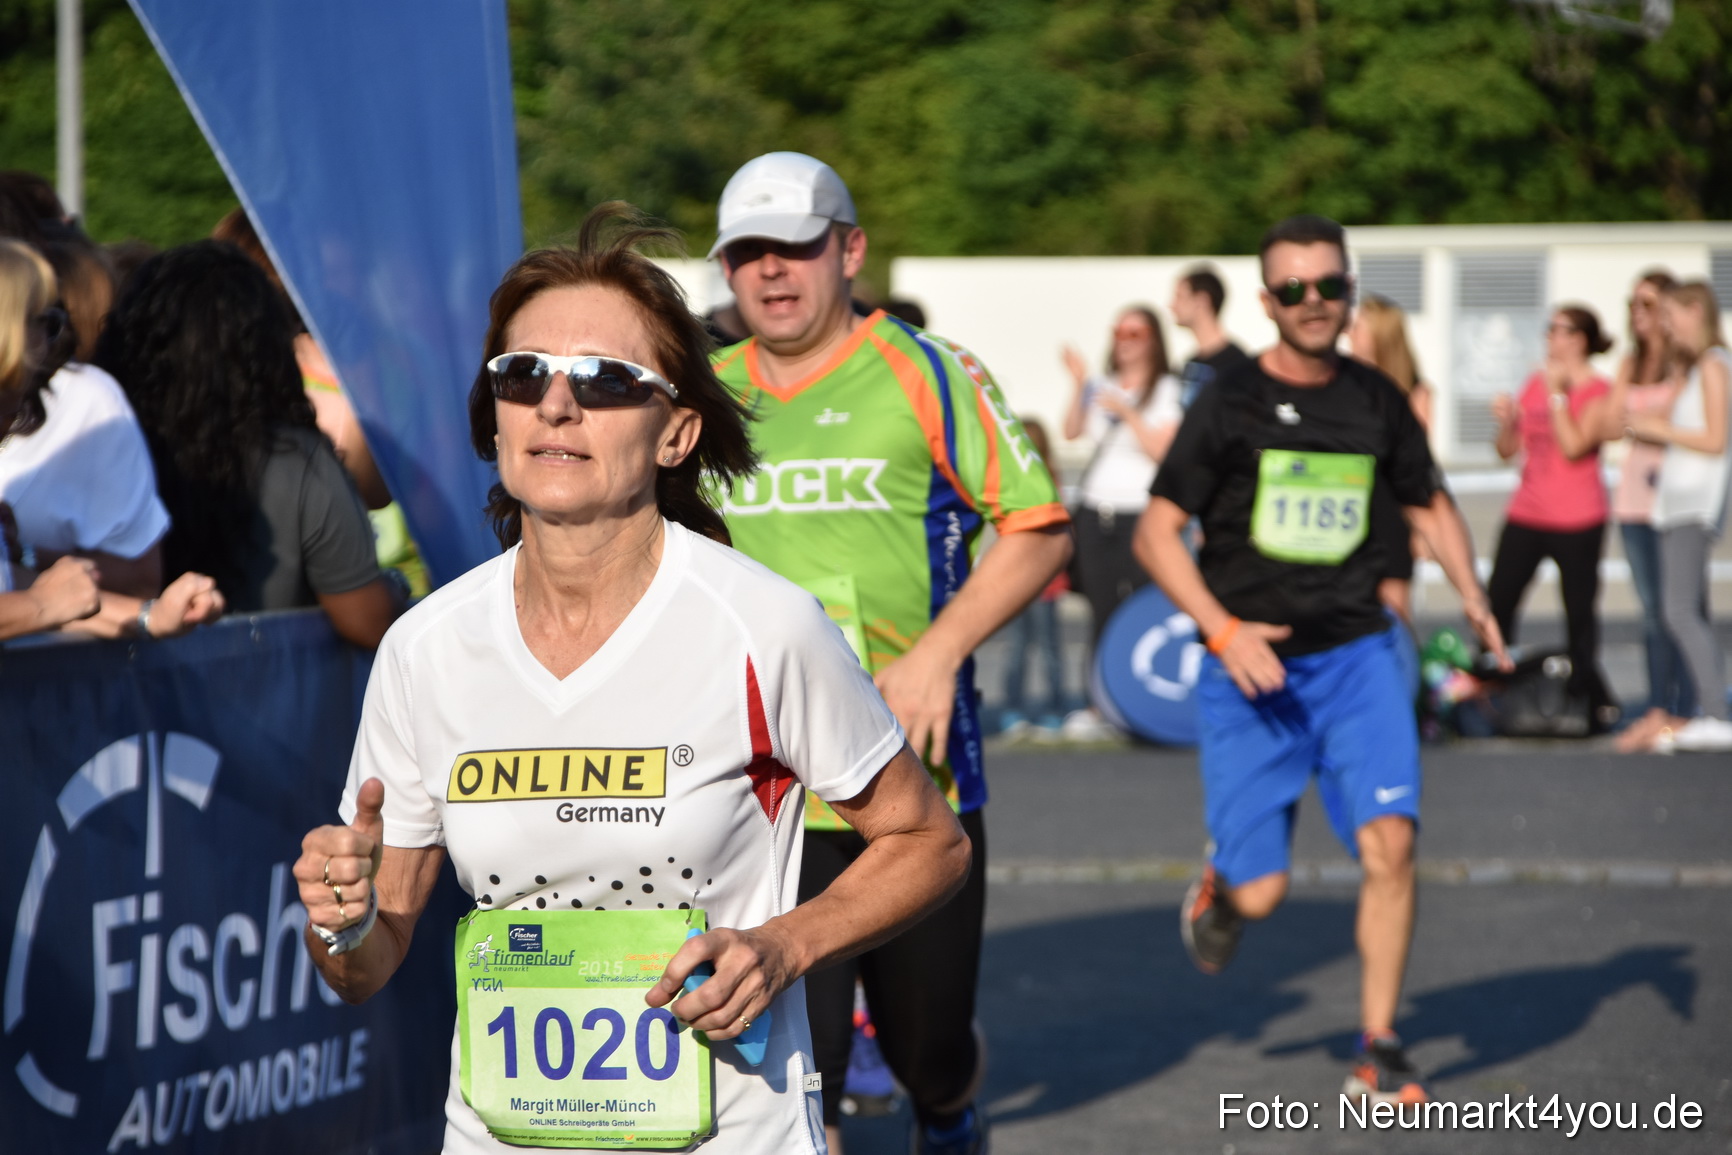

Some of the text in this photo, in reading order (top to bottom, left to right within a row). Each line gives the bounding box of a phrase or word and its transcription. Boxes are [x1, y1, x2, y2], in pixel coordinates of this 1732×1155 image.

[1273, 496, 1359, 531] 1185
[457, 754, 645, 796] ONLINE
[556, 802, 666, 827] Germany
[86, 863, 343, 1061] Fisch
[493, 949, 576, 966] firmenlauf
[578, 960, 624, 976] 2015
[487, 1006, 681, 1081] 1020
[106, 1028, 369, 1154] AUTOMOBILE
[510, 1097, 656, 1114] Margit Müller-Münch
[529, 1118, 635, 1128] ONLINE Schreibgeräte GmbH
